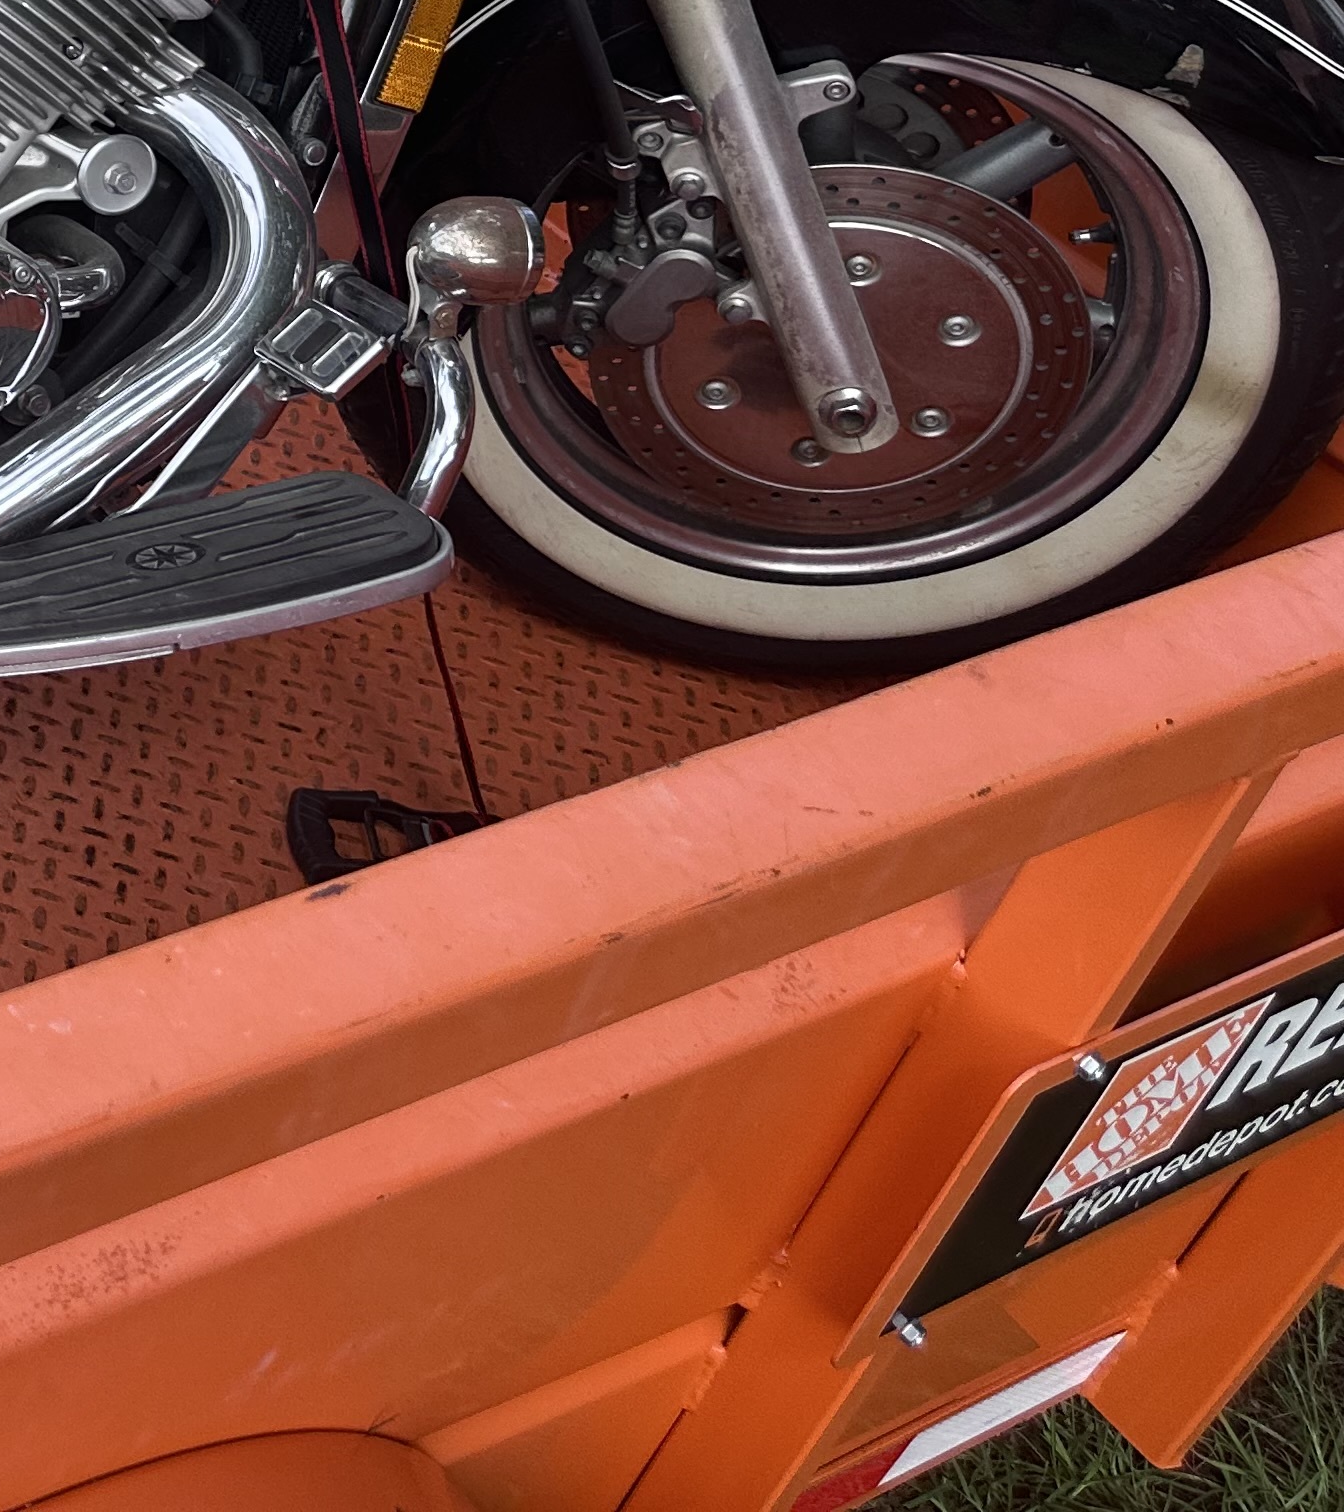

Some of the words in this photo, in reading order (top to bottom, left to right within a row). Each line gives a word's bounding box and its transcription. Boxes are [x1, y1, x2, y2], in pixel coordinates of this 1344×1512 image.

[1046, 1009, 1253, 1201] HOME
[1095, 1054, 1178, 1127] THE
[1206, 982, 1344, 1112] RE
[1091, 1059, 1221, 1181] DEPOT
